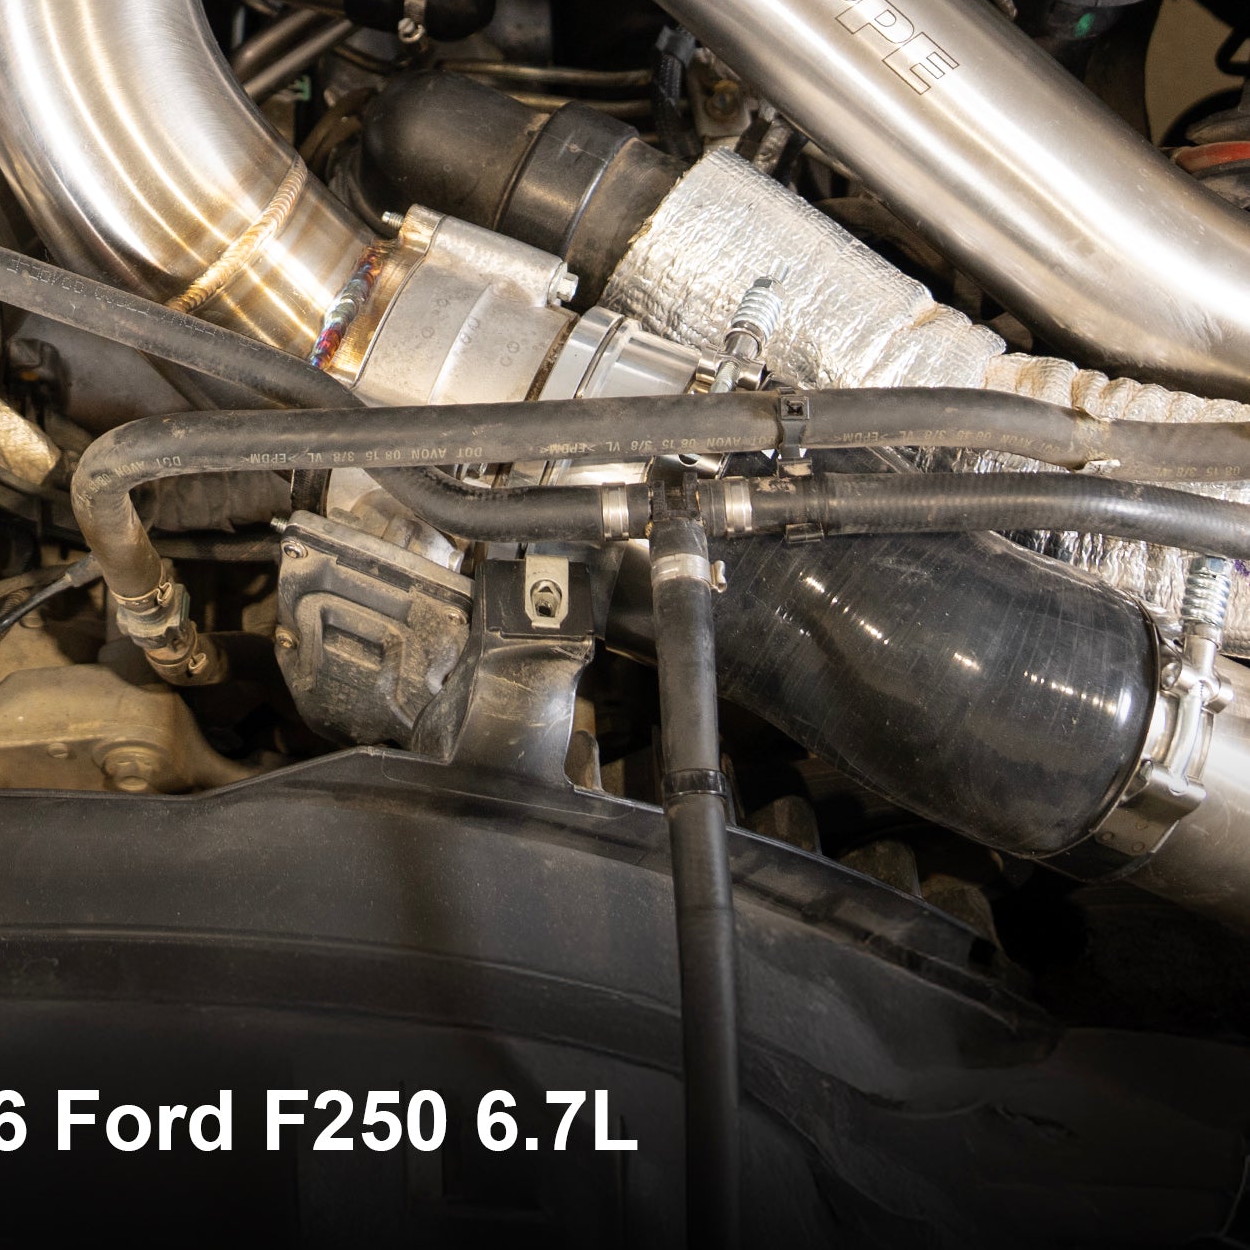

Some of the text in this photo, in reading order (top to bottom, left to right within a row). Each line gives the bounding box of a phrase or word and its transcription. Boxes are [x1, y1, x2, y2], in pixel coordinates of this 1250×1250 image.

[706, 437, 742, 448] AVON
[308, 452, 323, 463] VL
[332, 451, 355, 462] 3/8
[411, 448, 447, 460] AVON
[456, 447, 483, 458] DOT
[155, 455, 182, 468] DOT
[114, 461, 145, 478] AVON
